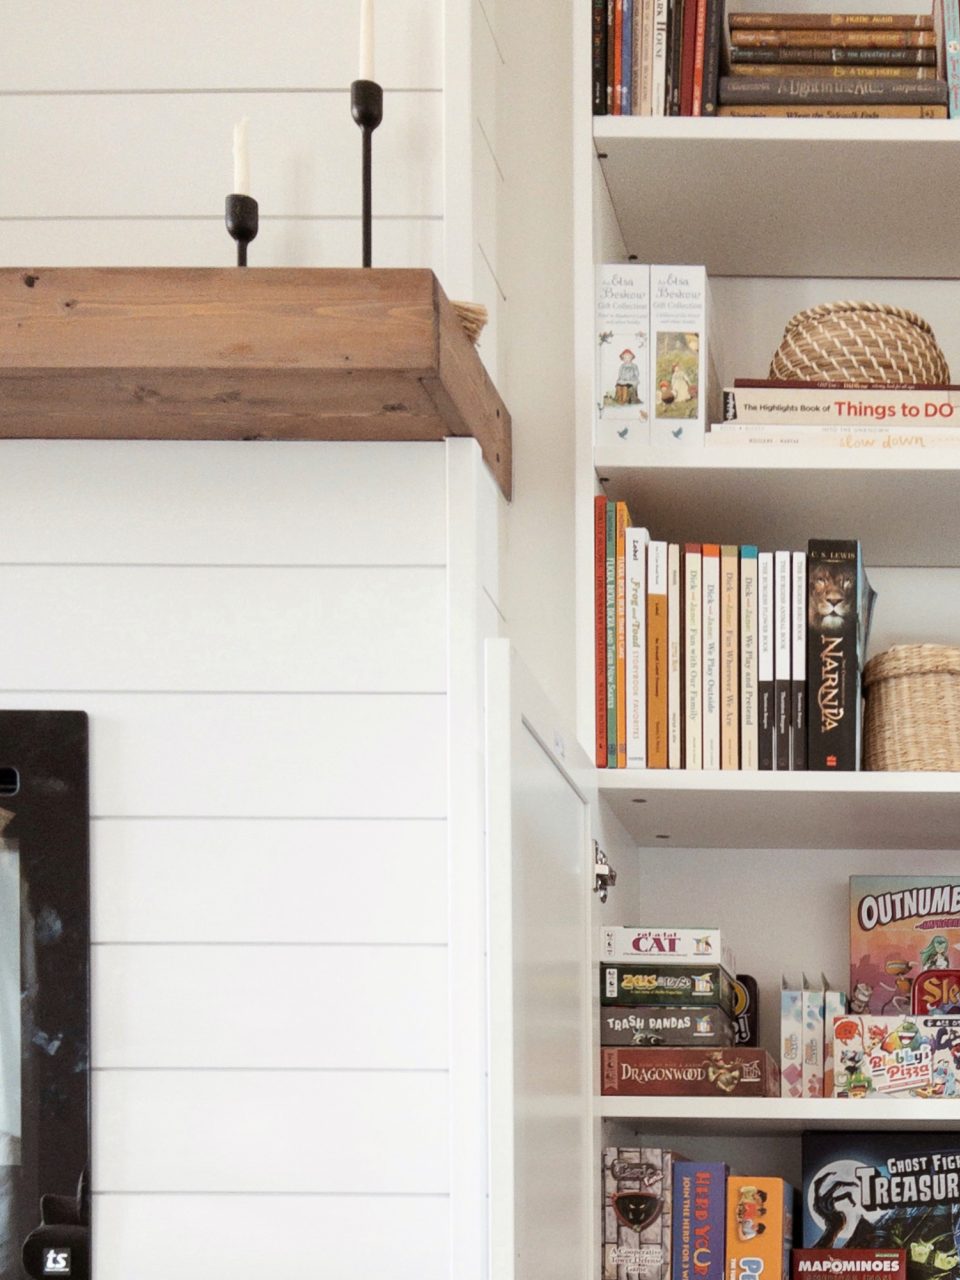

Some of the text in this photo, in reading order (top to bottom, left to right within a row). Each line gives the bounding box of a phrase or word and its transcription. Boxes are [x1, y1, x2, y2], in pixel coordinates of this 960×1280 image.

[744, 404, 831, 414] The Highlights Book of
[834, 401, 954, 420] Things to DO
[840, 436, 926, 449] slow down
[830, 552, 856, 560] LEWIS
[631, 578, 641, 607] Frog
[631, 620, 641, 649] Toad
[689, 570, 699, 721] Dick Jane: Fun with Our Family
[706, 584, 715, 714] Dick Jane: We Play Outside
[725, 572, 734, 727] Dick Jane: Fun Wherever We Are
[744, 577, 753, 726] Dick Jane: We Play and Pretend
[817, 634, 846, 734] NARNIA
[632, 937, 681, 953] CAT
[607, 1015, 691, 1030] TRASH PANDAS
[869, 1044, 932, 1072] Blobby's
[621, 1063, 706, 1084] DRAGONWOOD
[886, 1063, 930, 1082] Pizza
[887, 1157, 928, 1174] GHOST
[681, 1177, 691, 1198] JOIN
[693, 1172, 712, 1221] HERD
[681, 1200, 691, 1217] THE
[681, 1218, 691, 1243] HERD
[681, 1245, 691, 1262] FOR
[693, 1225, 712, 1274] YOUR
[798, 1260, 900, 1273] MAPOMINOES
